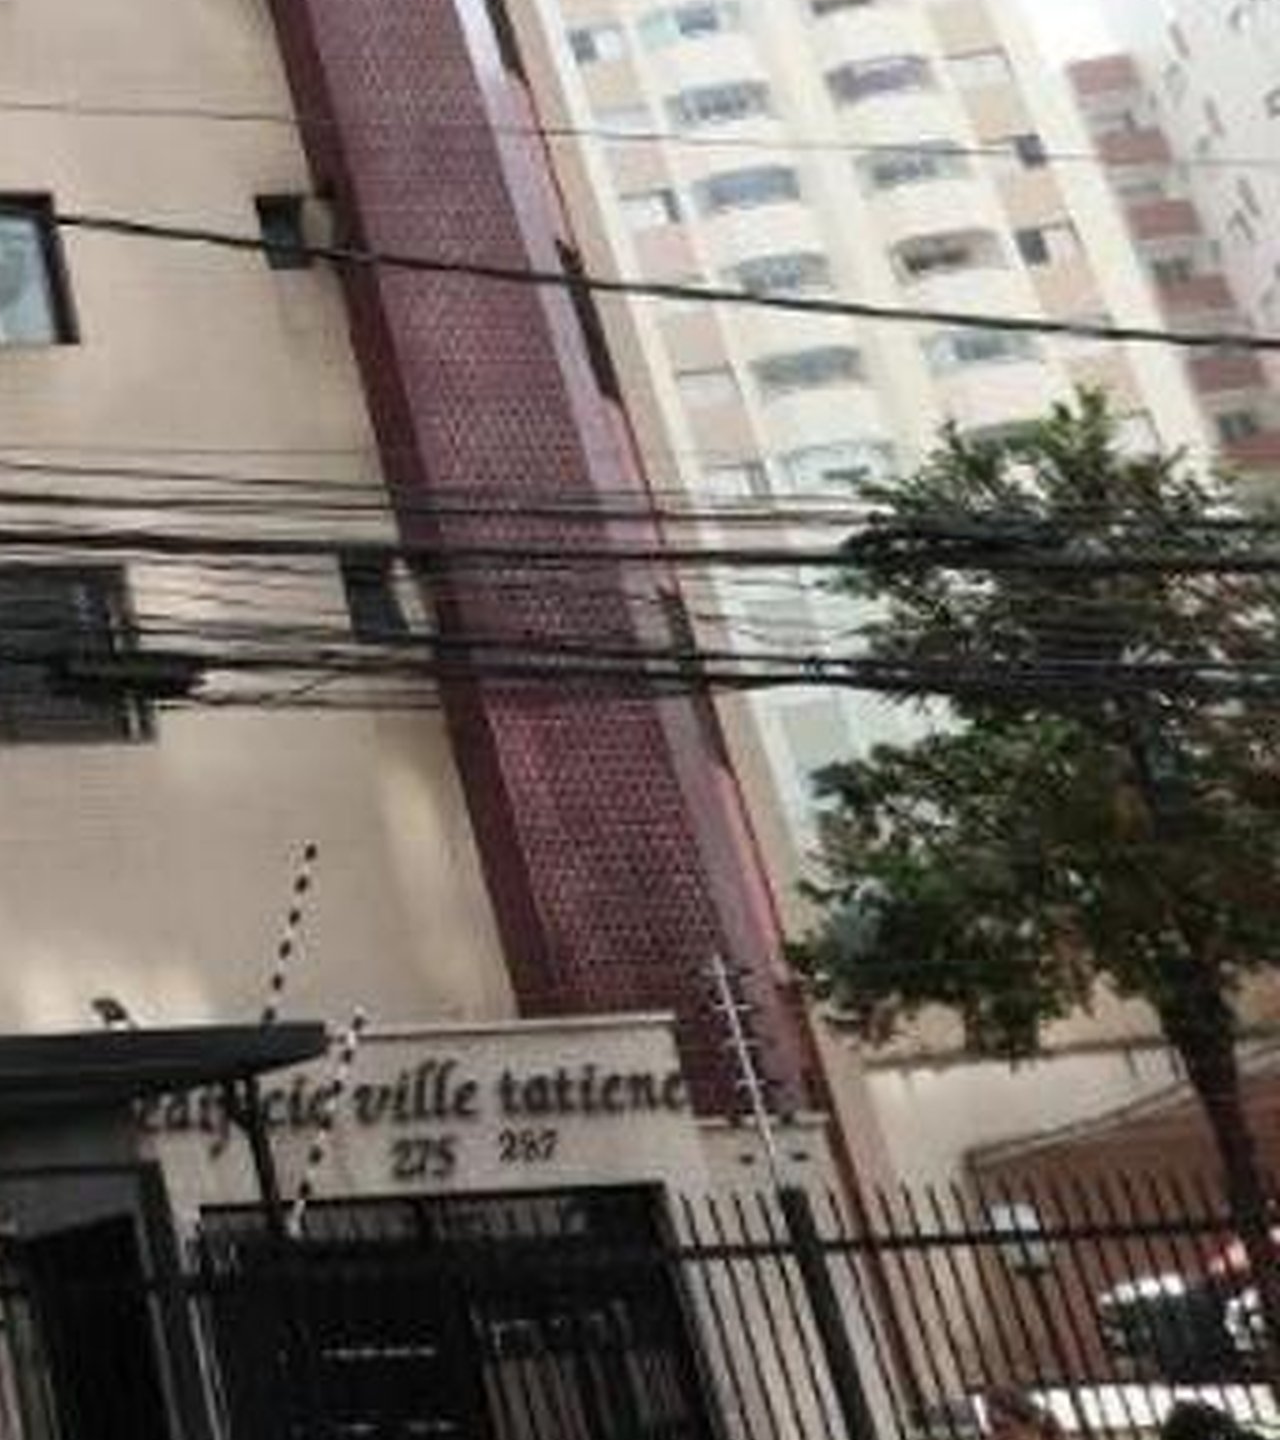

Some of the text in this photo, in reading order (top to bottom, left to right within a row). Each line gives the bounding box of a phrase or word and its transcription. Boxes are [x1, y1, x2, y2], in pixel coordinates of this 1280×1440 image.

[352, 1058, 478, 1124] ville
[391, 1127, 559, 1180] 275 287
